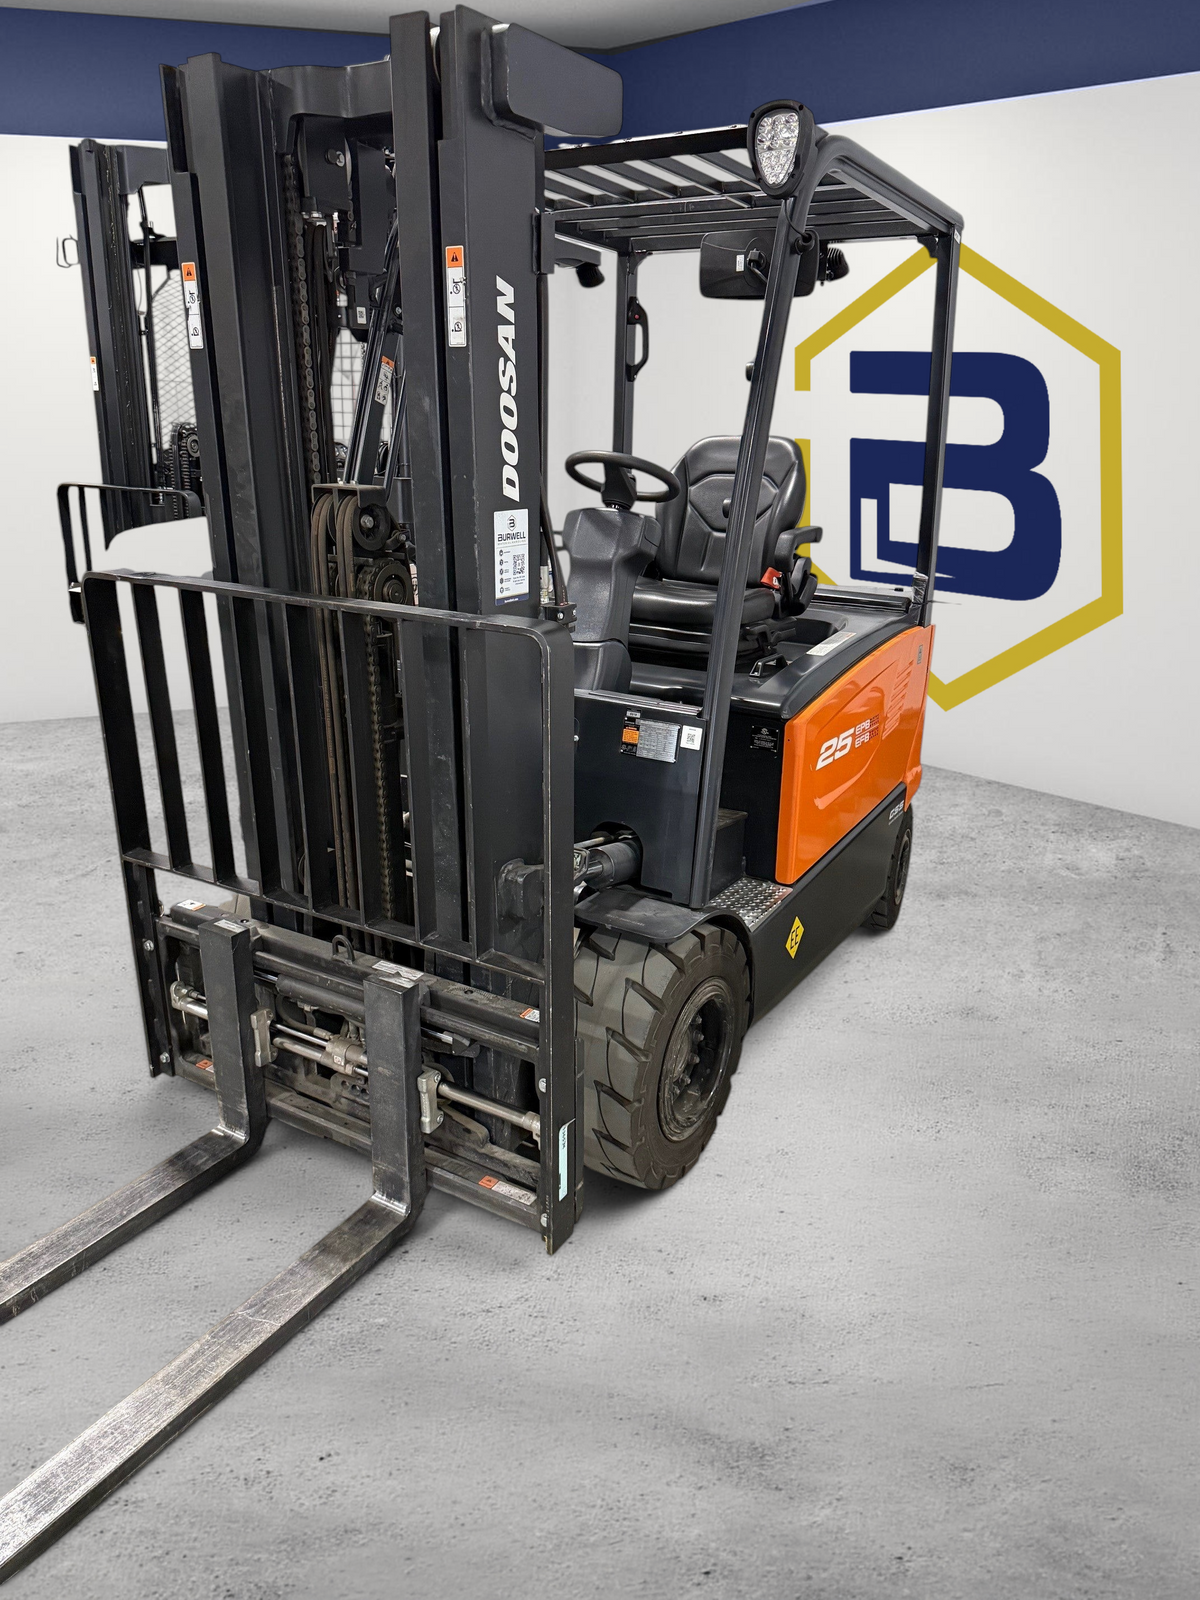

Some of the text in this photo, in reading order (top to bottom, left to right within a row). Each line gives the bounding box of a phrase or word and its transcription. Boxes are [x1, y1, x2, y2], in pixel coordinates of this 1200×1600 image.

[496, 275, 520, 502] DOOSAN
[497, 531, 526, 542] BURWELL
[815, 727, 855, 771] 25
[790, 925, 800, 950] EE
